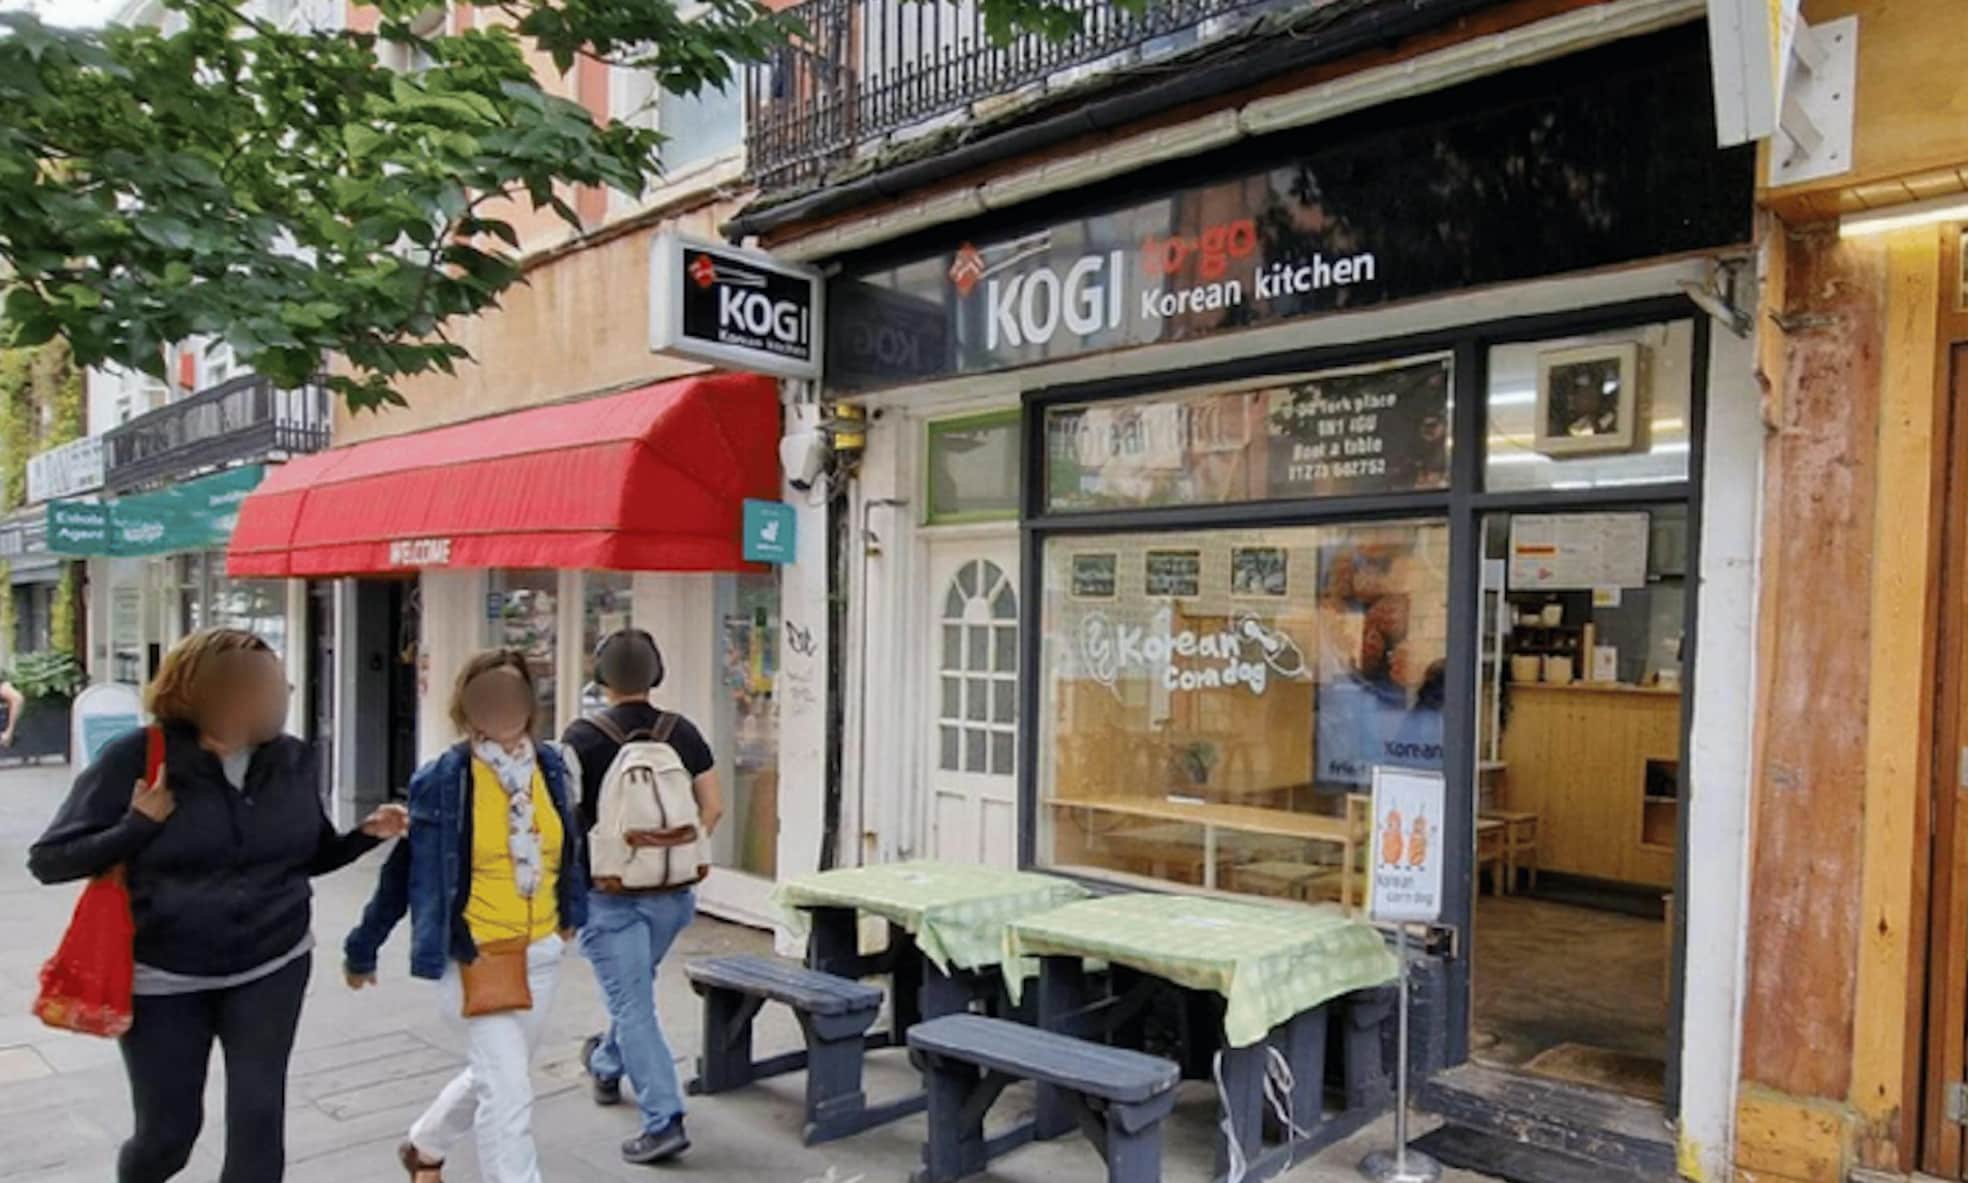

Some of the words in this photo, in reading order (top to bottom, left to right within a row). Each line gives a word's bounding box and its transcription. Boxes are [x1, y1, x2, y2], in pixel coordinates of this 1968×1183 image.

[720, 285, 808, 345] KOGI
[987, 250, 1123, 351] KOGI
[1141, 280, 1241, 319] Korean
[1255, 252, 1375, 300] kitchen
[390, 538, 450, 566] WELCOME
[1117, 624, 1242, 667] Korean
